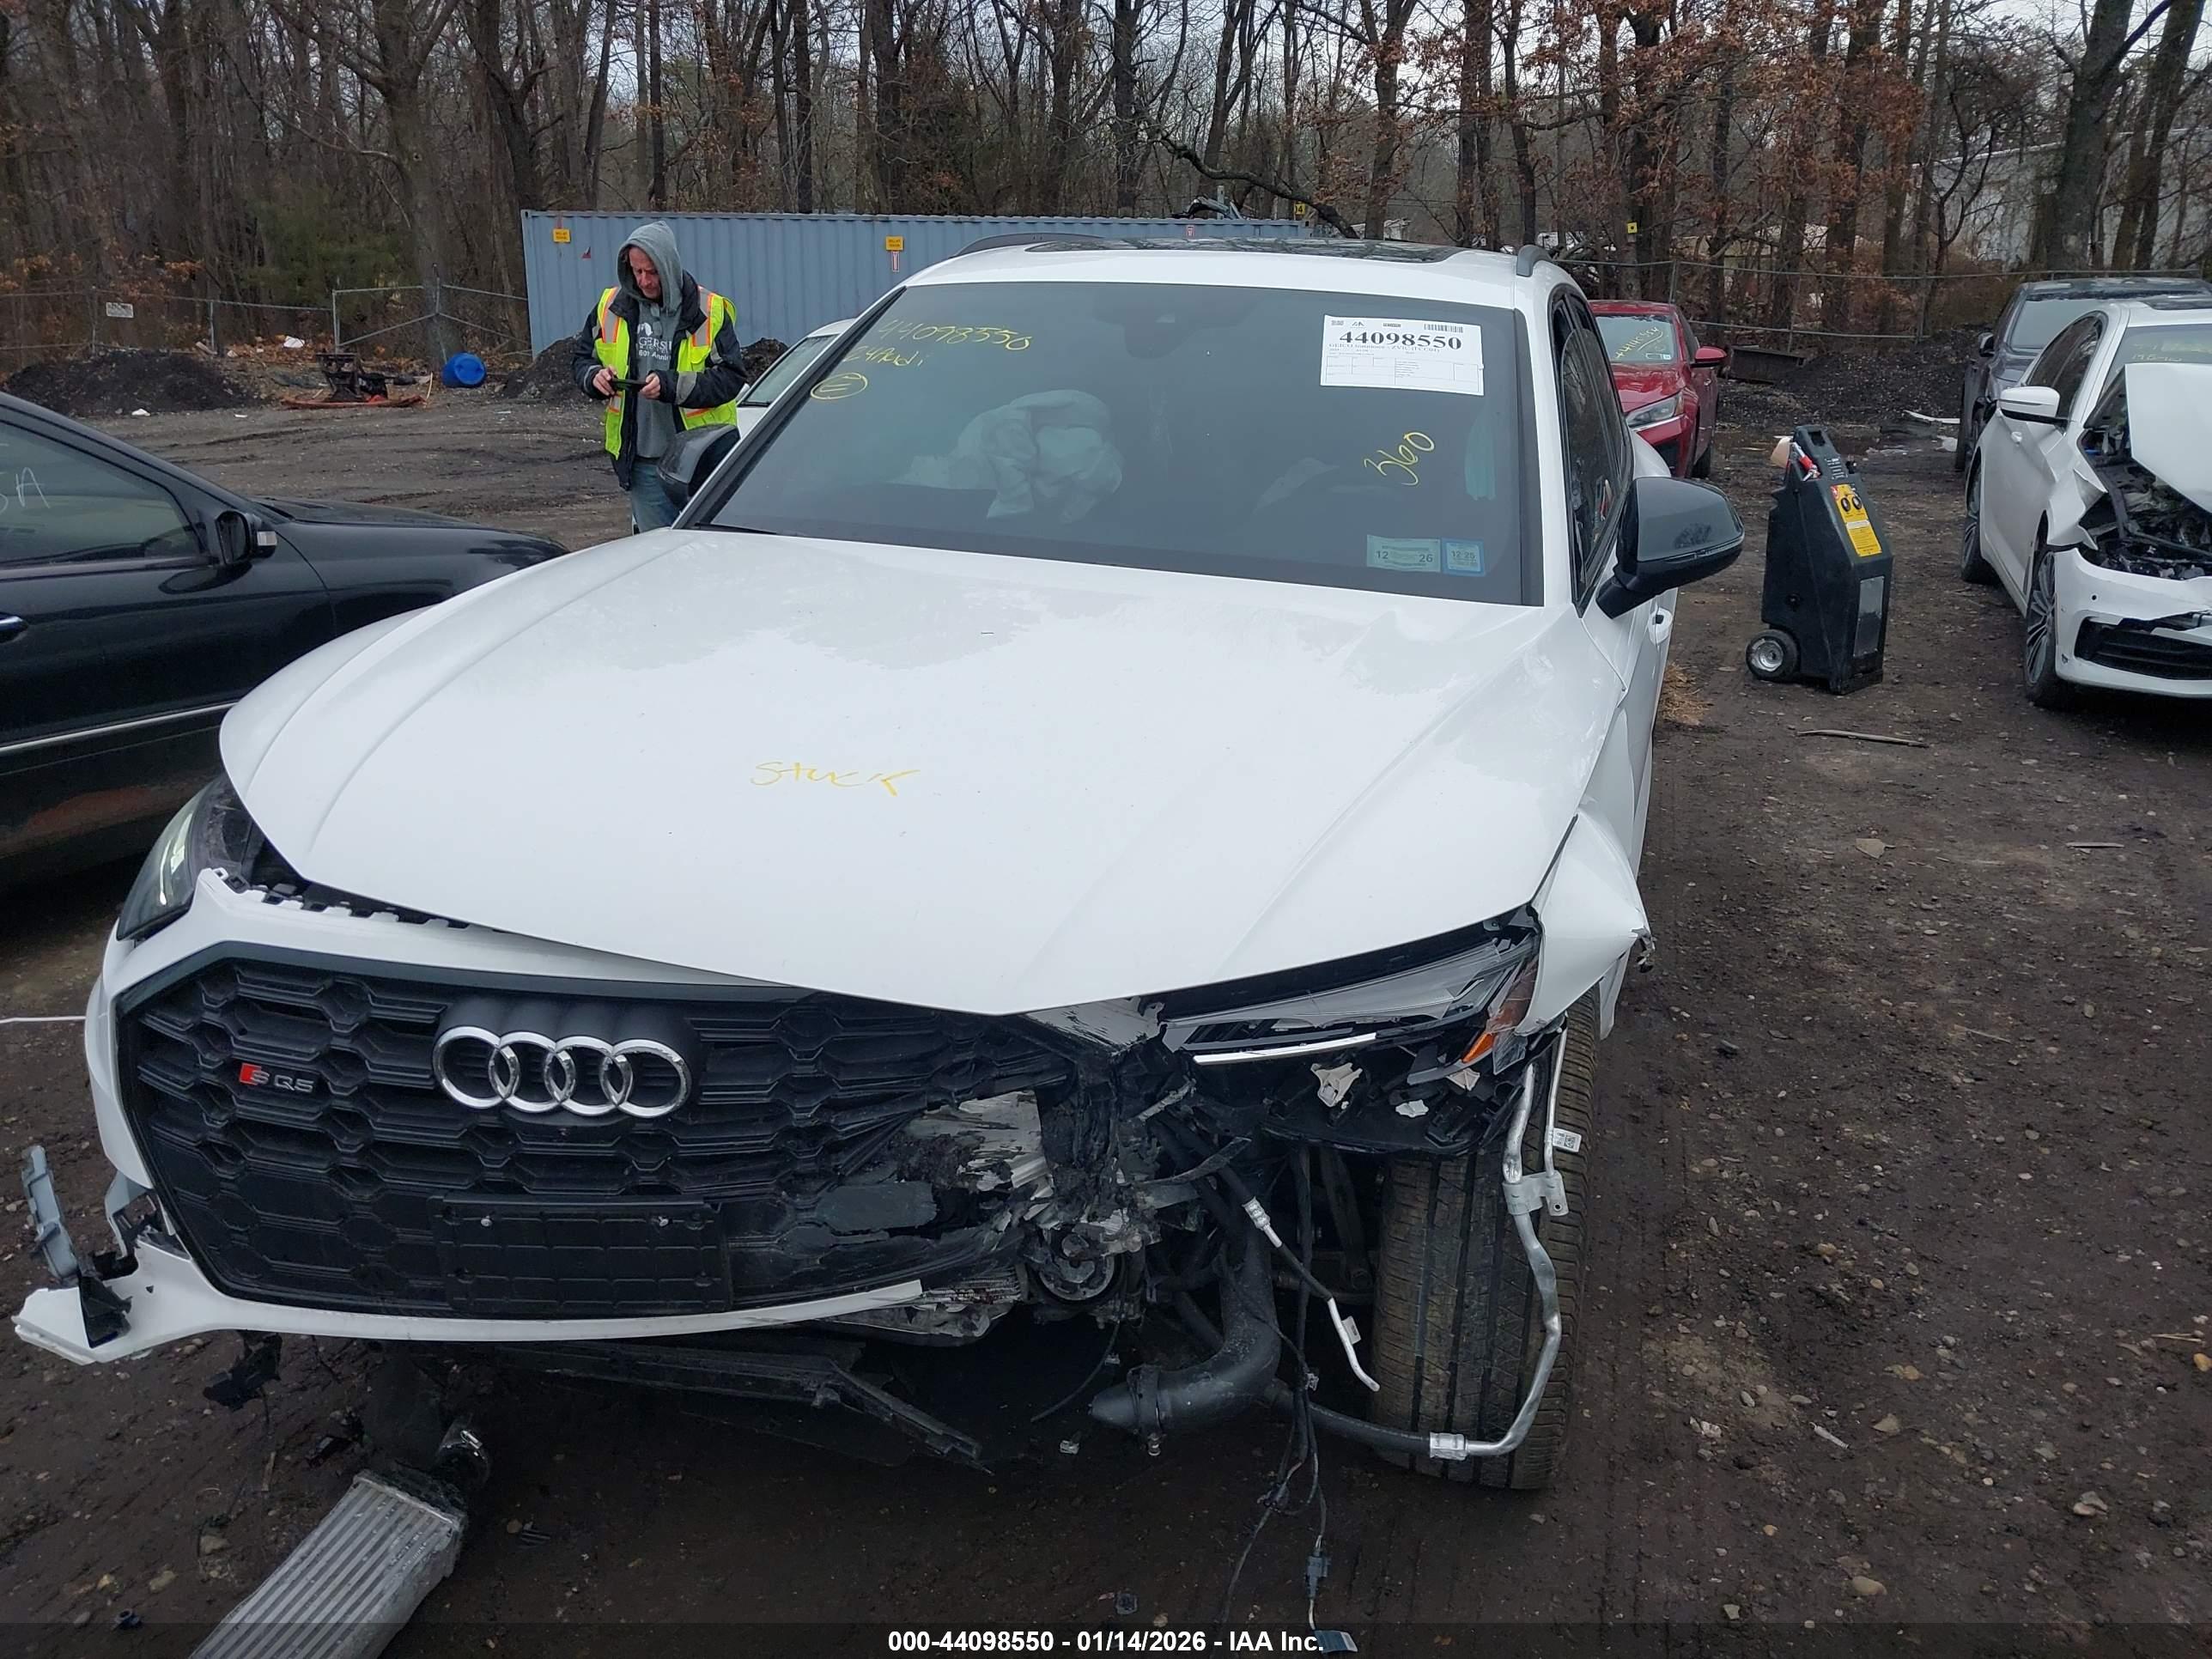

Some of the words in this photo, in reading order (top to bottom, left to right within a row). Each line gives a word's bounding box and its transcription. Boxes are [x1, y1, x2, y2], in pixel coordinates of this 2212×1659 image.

[1340, 331, 1462, 349] 44098550
[1364, 432, 1435, 486] 360
[1376, 550, 1389, 559] 12
[1419, 554, 1433, 562] 26
